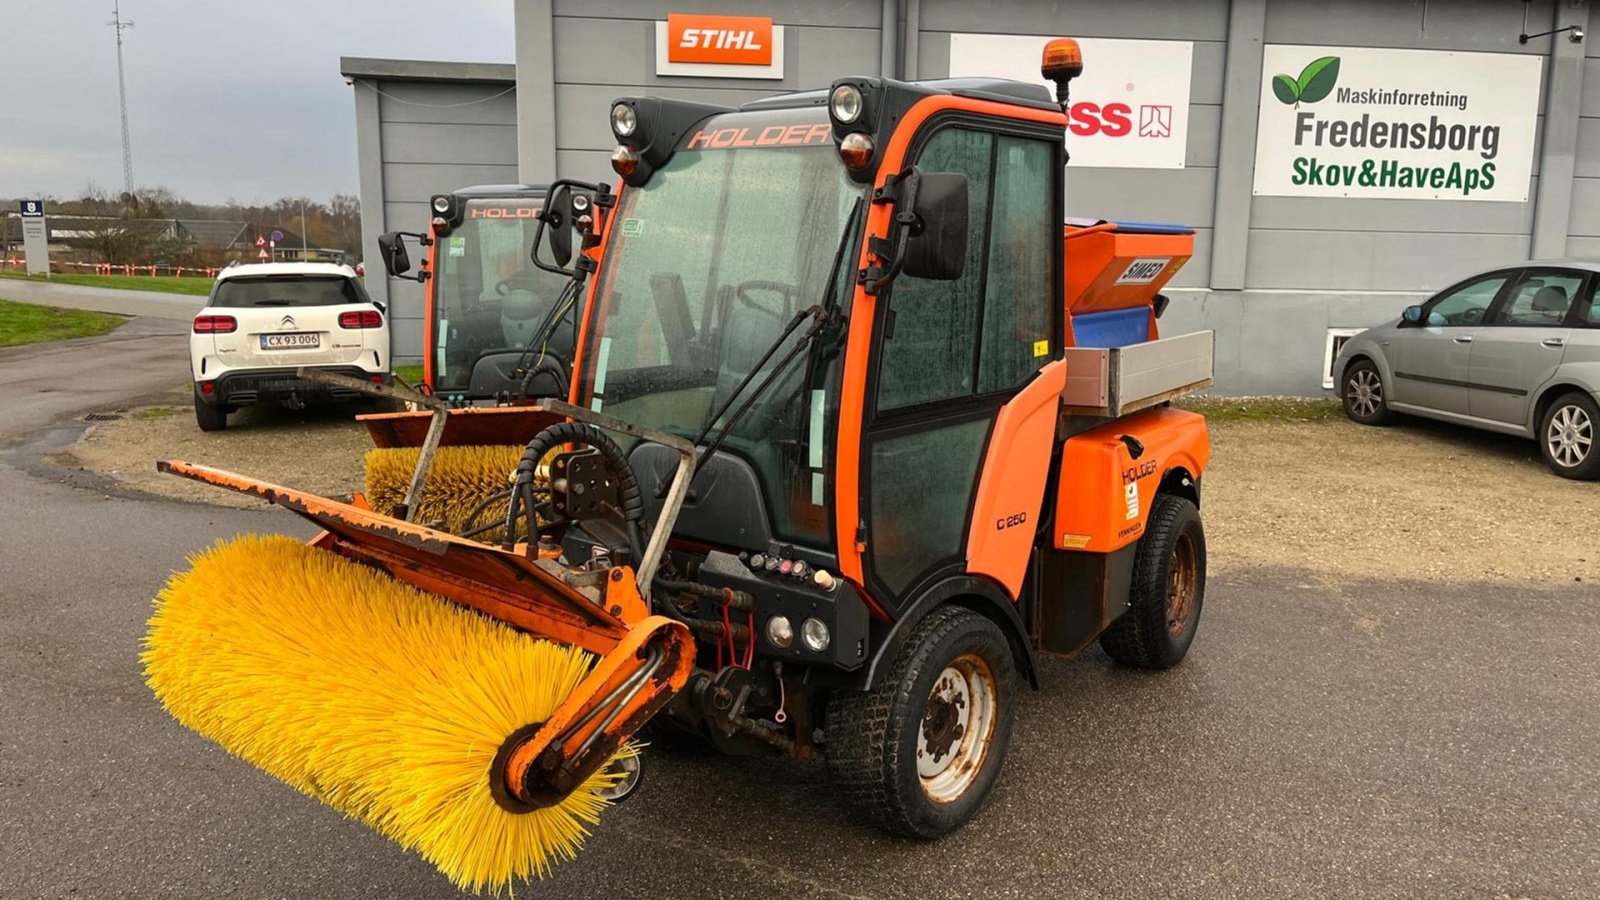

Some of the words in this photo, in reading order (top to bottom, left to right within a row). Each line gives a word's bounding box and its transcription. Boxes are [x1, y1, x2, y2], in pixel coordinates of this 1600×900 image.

[680, 28, 762, 50] STIHL
[1337, 87, 1468, 111] Maskinforretning
[687, 122, 833, 149] HOLDER
[1294, 111, 1501, 160] Fredensborg
[1291, 156, 1497, 196] Skov&HaveApS
[1122, 262, 1165, 280] SIMED
[269, 336, 282, 346] CX
[284, 335, 297, 345] 93
[298, 334, 318, 344] 006
[1122, 459, 1157, 485] HOLDER
[1006, 511, 1027, 528] 250
